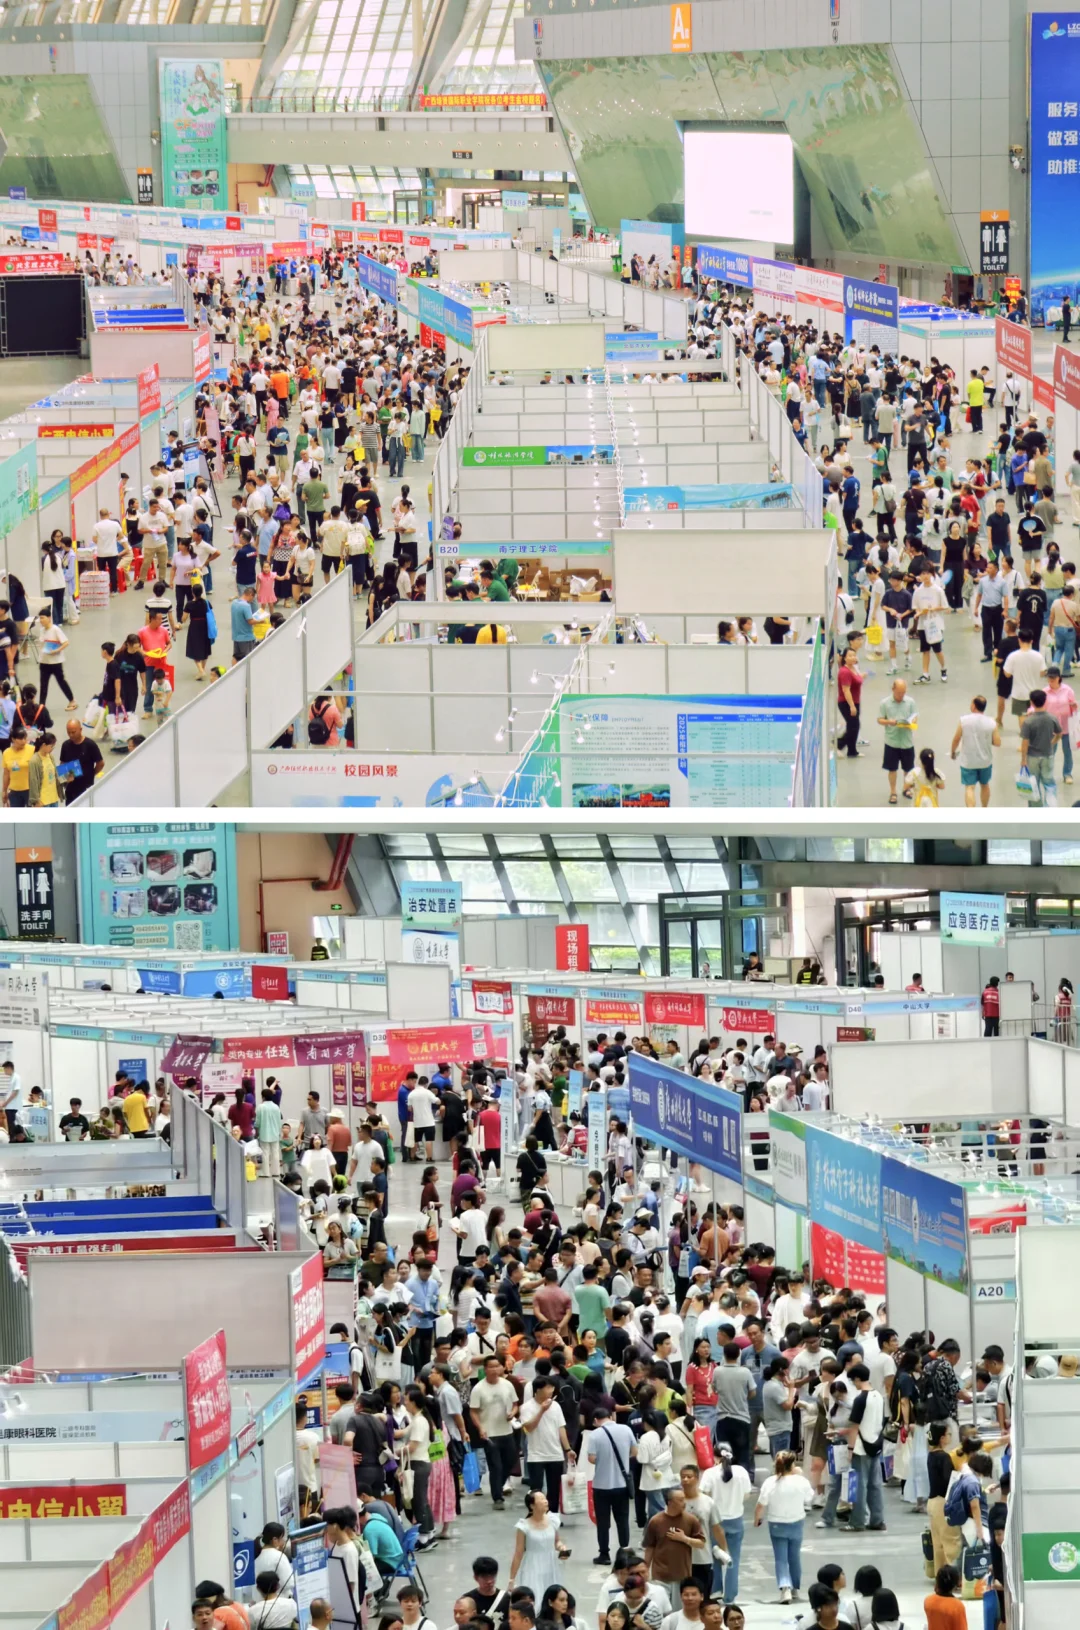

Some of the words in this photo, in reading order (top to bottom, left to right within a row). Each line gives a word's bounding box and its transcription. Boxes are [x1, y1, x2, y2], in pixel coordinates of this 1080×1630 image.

[1048, 102, 1080, 117] 服务
[1048, 131, 1080, 146] 做强
[1048, 160, 1080, 174] 助推
[983, 256, 1007, 264] 洗手间
[499, 545, 557, 553] 南宁理工学院
[344, 764, 398, 777] 校园风景
[408, 898, 457, 913] 治安处置点
[21, 910, 51, 921] 洗手间
[948, 911, 999, 931] 应急医疗点
[21, 922, 48, 930] TOILET
[567, 930, 578, 971] 现场租
[903, 1002, 930, 1010] 中山大学
[228, 1049, 263, 1059] 类内专业
[264, 1044, 290, 1058] 任选
[978, 1286, 1003, 1297] A20
[0, 1496, 124, 1518] 电信小翼
